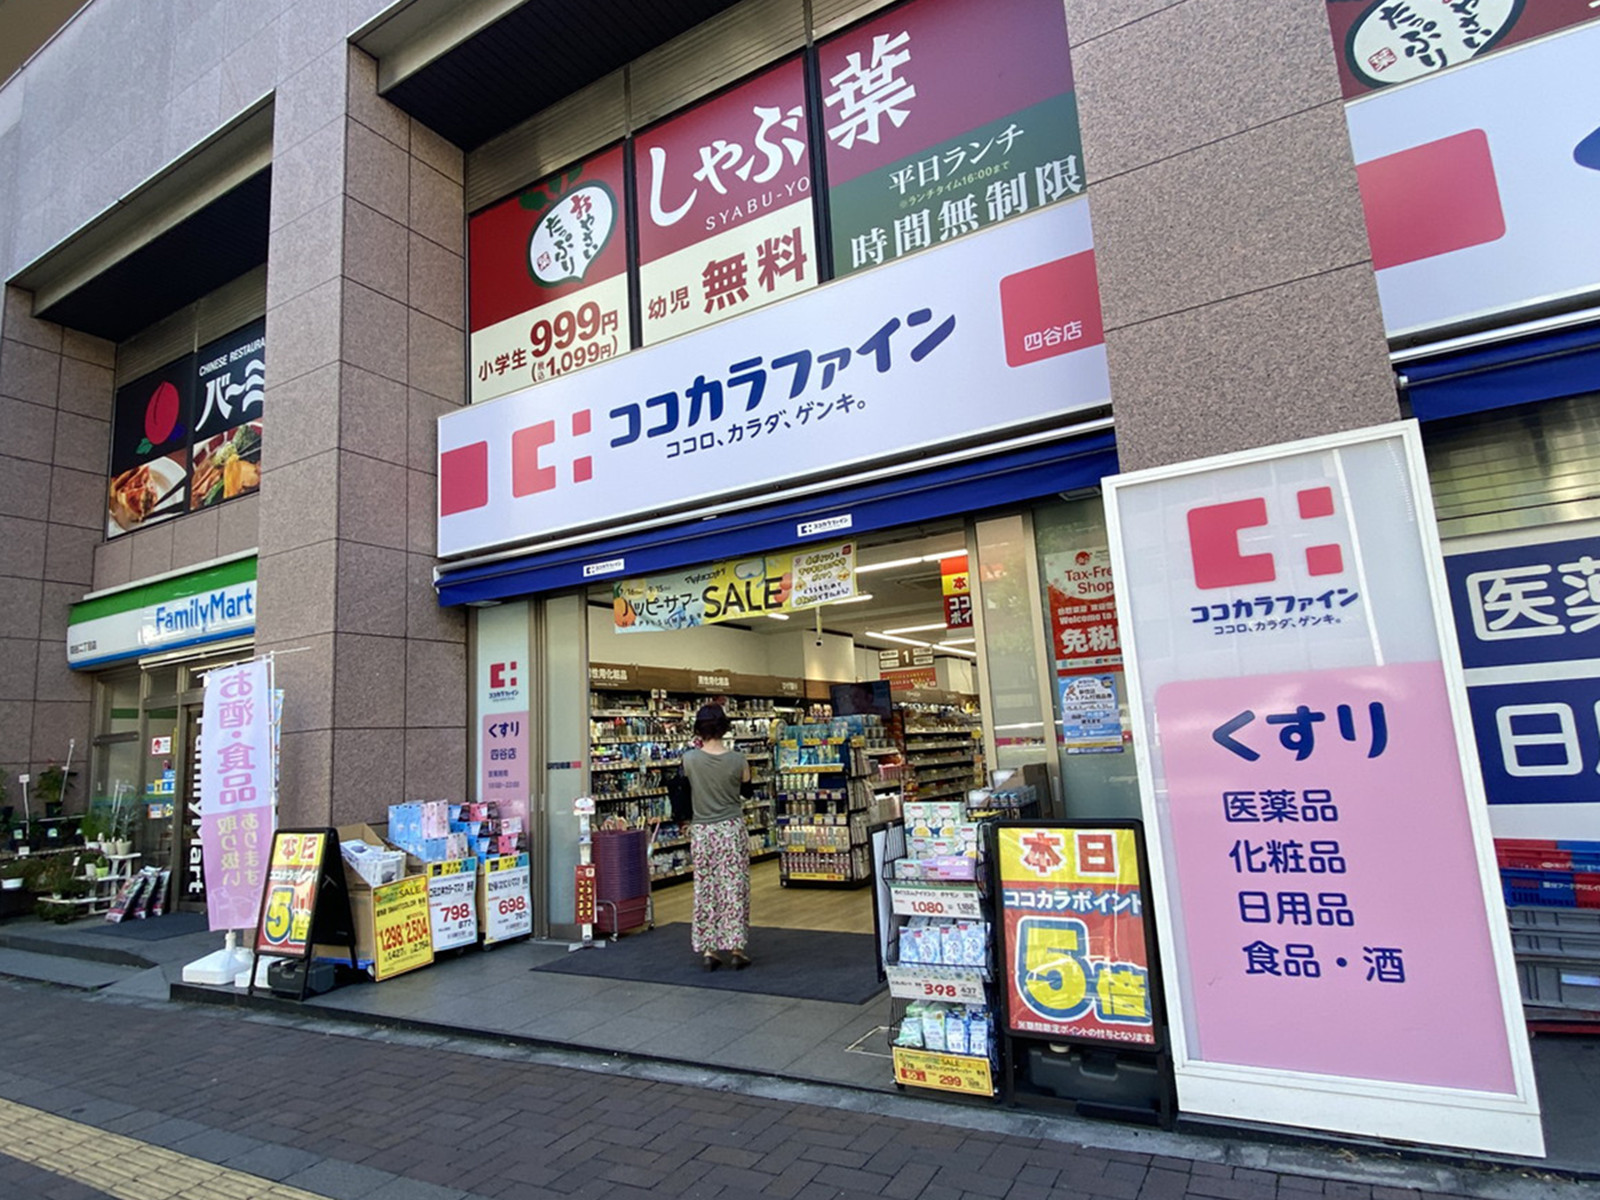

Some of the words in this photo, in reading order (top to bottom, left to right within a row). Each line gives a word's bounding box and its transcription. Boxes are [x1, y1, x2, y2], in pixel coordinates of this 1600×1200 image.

[649, 31, 917, 227] しゃぶ葉
[889, 124, 1024, 195] 平日ランチ
[705, 176, 811, 231] SYABU-YO
[850, 155, 1083, 268] 時間無制限
[648, 286, 690, 321] 幼児
[701, 227, 807, 314] 無料
[478, 348, 527, 382] 小学生
[530, 301, 619, 358] 999円
[1023, 321, 1083, 353] 四谷店
[199, 355, 228, 377] CHINESE
[609, 307, 956, 449] ココカラファイン
[666, 392, 867, 459] ココロ、カラダ、ゲンキ。
[622, 593, 699, 617] ハッピーサマー
[702, 576, 784, 619] SALE
[1077, 581, 1114, 595] Shop
[1191, 588, 1359, 623] ココカラファイン
[156, 588, 253, 633] FamilyMart
[1214, 614, 1341, 635] ココロ、カラダ、ゲンキ。
[903, 650, 910, 664] 1
[1061, 625, 1121, 655] 免税
[589, 667, 628, 681] 性用化粧品
[488, 720, 520, 738] くすり
[1212, 701, 1388, 762] くすり
[1495, 700, 1600, 778] 日
[490, 748, 517, 761] 四谷店
[1223, 789, 1339, 824] 医薬品
[1019, 831, 1119, 875] 本日
[1229, 840, 1346, 875] 化粧品
[440, 903, 470, 923] 798
[498, 896, 526, 915] 698
[1003, 888, 1143, 915] ココカラポイント
[1239, 892, 1354, 927] 日用品
[1016, 916, 1153, 1024] 5倍
[1243, 941, 1406, 984] 食品・酒
[924, 983, 957, 997] 398
[939, 1074, 962, 1086] 299
